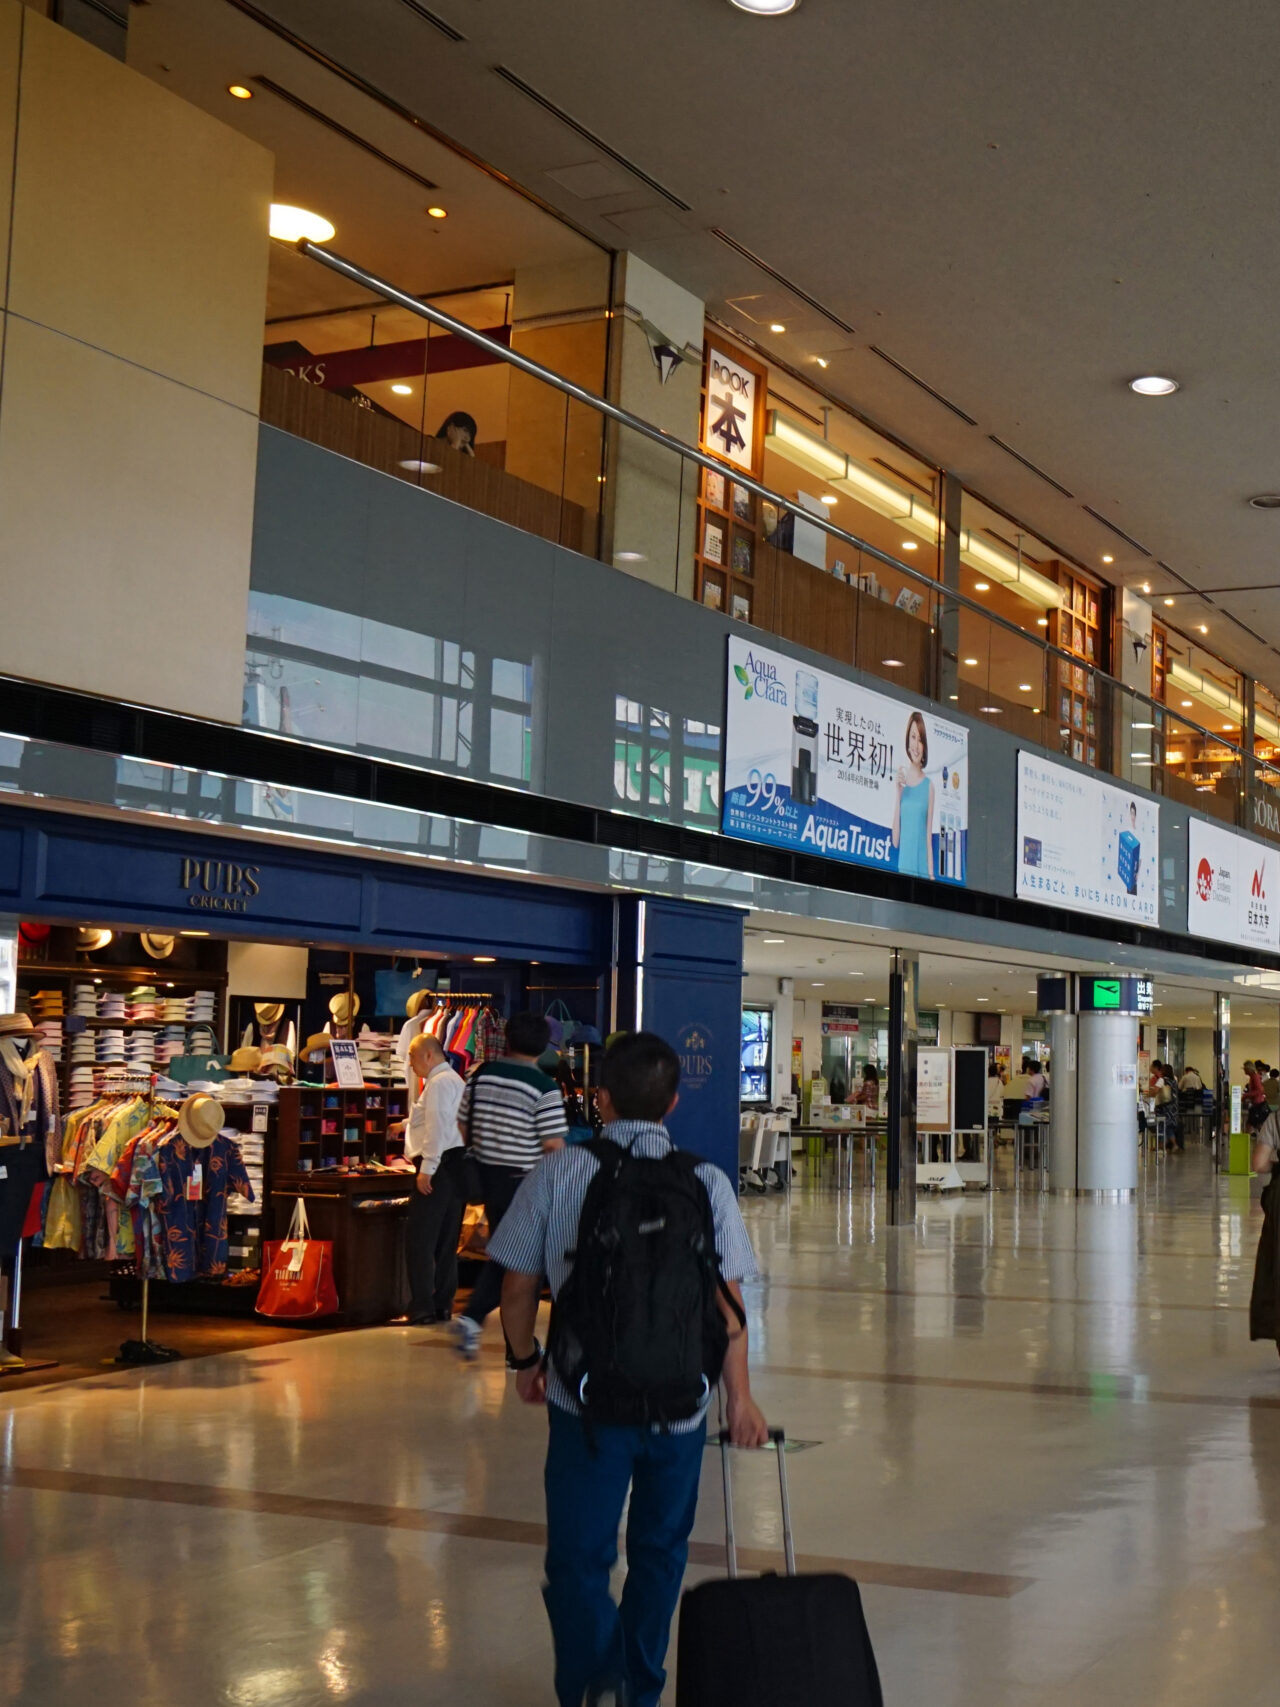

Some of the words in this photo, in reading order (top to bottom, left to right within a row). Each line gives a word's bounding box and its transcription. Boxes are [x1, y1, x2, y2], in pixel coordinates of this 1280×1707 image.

[712, 359, 749, 399] BOOK
[710, 392, 747, 454] 本
[744, 650, 777, 681] Aqua
[753, 674, 788, 706] Clara
[800, 814, 891, 862] AquaTrust
[182, 857, 260, 897] PUBS
[189, 894, 248, 913] CRICKET
[1104, 892, 1128, 908] AEON
[1131, 899, 1154, 915] CARD
[1248, 910, 1270, 929] 日本大学
[334, 1045, 354, 1054] SALE
